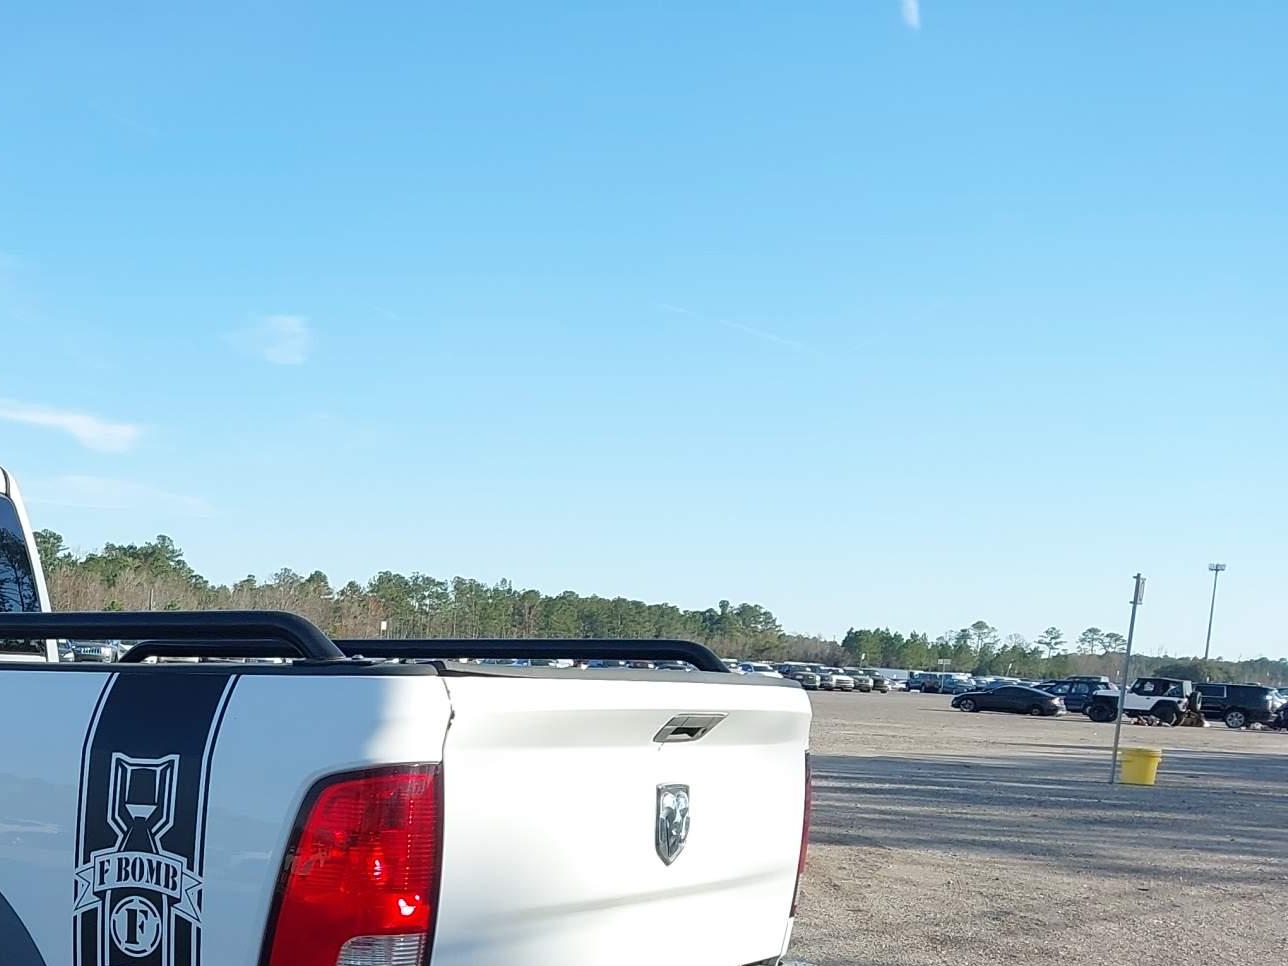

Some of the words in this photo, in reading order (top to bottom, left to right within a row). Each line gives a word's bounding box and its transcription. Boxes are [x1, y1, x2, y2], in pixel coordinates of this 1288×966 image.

[98, 859, 111, 886] F
[115, 856, 178, 892] BOMB
[124, 907, 149, 945] F
